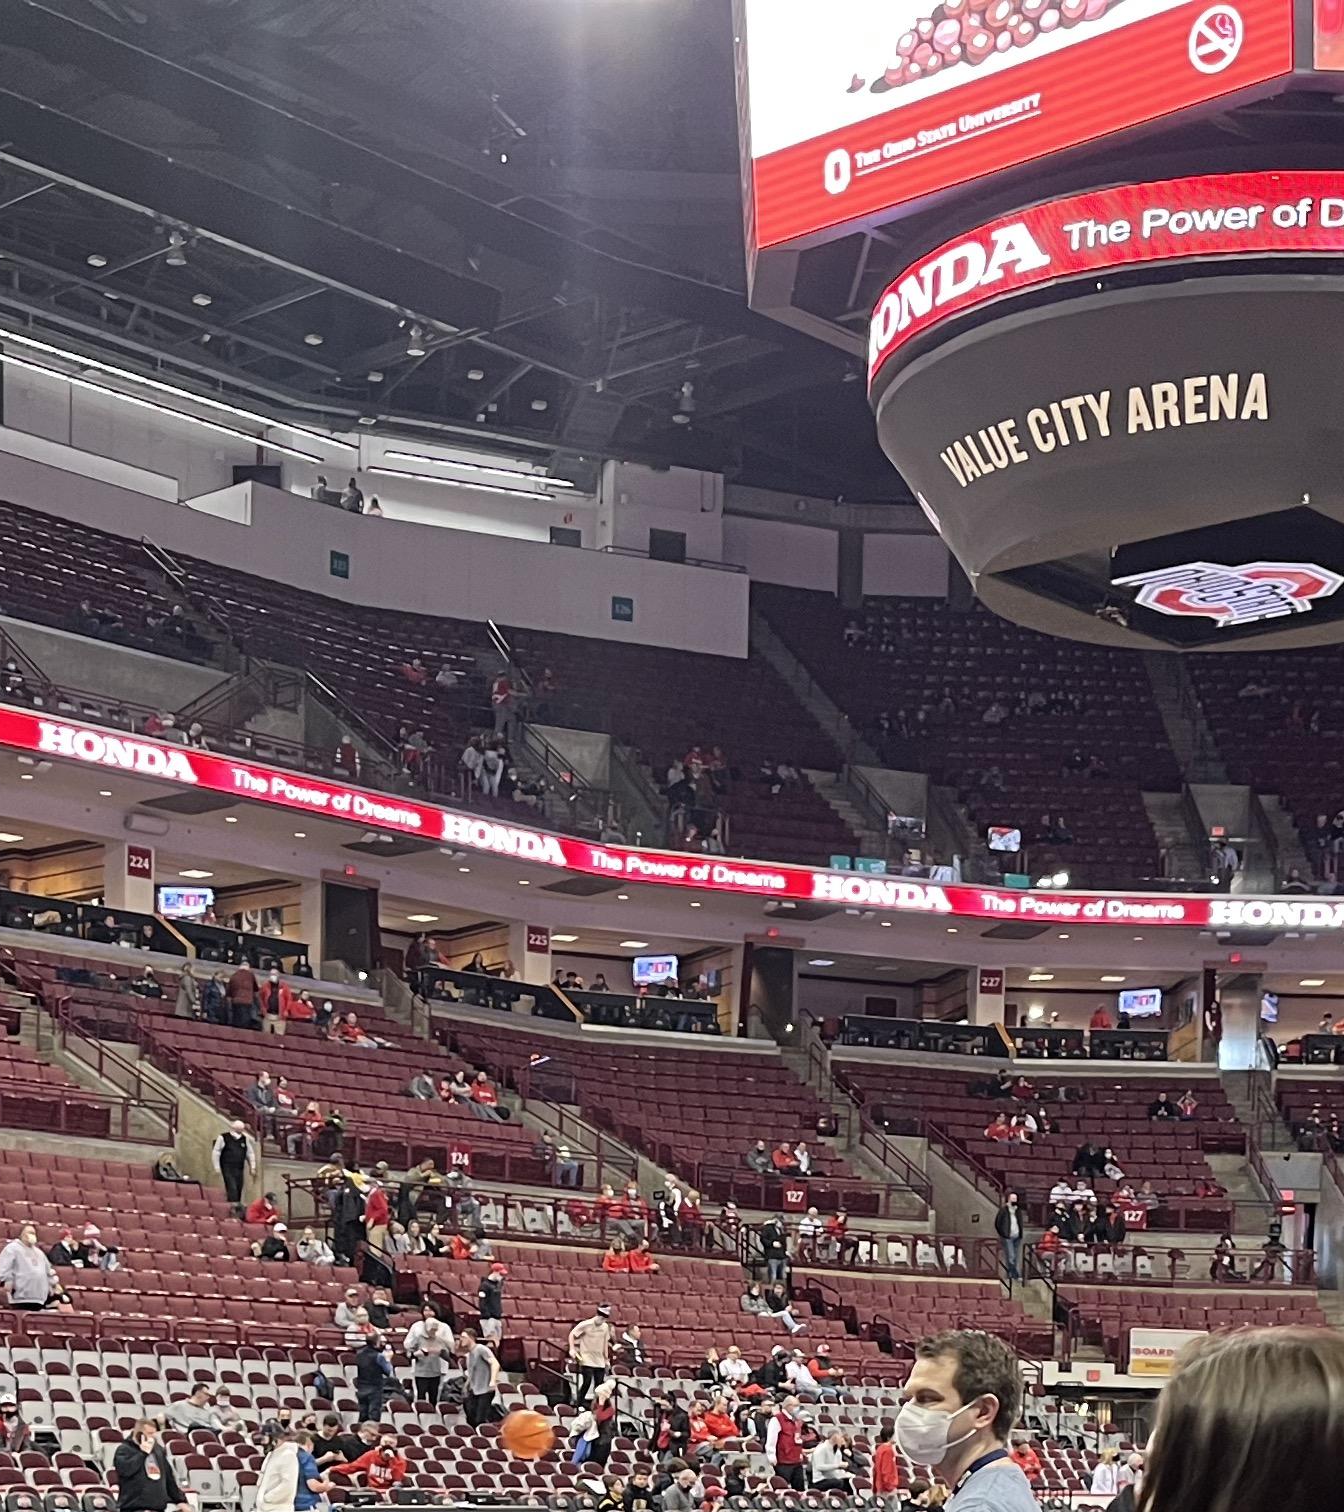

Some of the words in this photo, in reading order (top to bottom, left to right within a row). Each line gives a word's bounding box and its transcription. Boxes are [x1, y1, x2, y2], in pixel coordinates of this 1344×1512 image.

[958, 92, 1041, 133] UNIVERSITY
[1062, 219, 1131, 252] The
[1141, 204, 1265, 239] Power
[1271, 197, 1313, 228] of
[939, 418, 1030, 488] VALUE
[1026, 389, 1111, 454] CITY
[1127, 372, 1269, 434] ARENA
[38, 720, 199, 783] HONDA
[231, 768, 268, 794] The
[271, 777, 328, 808] Power
[331, 792, 352, 812] of
[353, 796, 422, 828] Dreams
[441, 812, 567, 866] HONDA
[591, 850, 622, 872] The
[626, 856, 688, 879] Power
[690, 865, 711, 882] of
[713, 867, 785, 890] Dreams
[812, 873, 953, 911] HONDA
[981, 894, 1017, 913] The
[1020, 897, 1081, 917] Power
[1083, 900, 1105, 917] of
[1107, 901, 1185, 920] Dreams
[129, 855, 150, 870] 224
[527, 933, 548, 946] 225
[981, 976, 1001, 988] 227
[450, 1152, 470, 1166] 124
[786, 1190, 805, 1203] 127
[1123, 1210, 1144, 1222] 127
